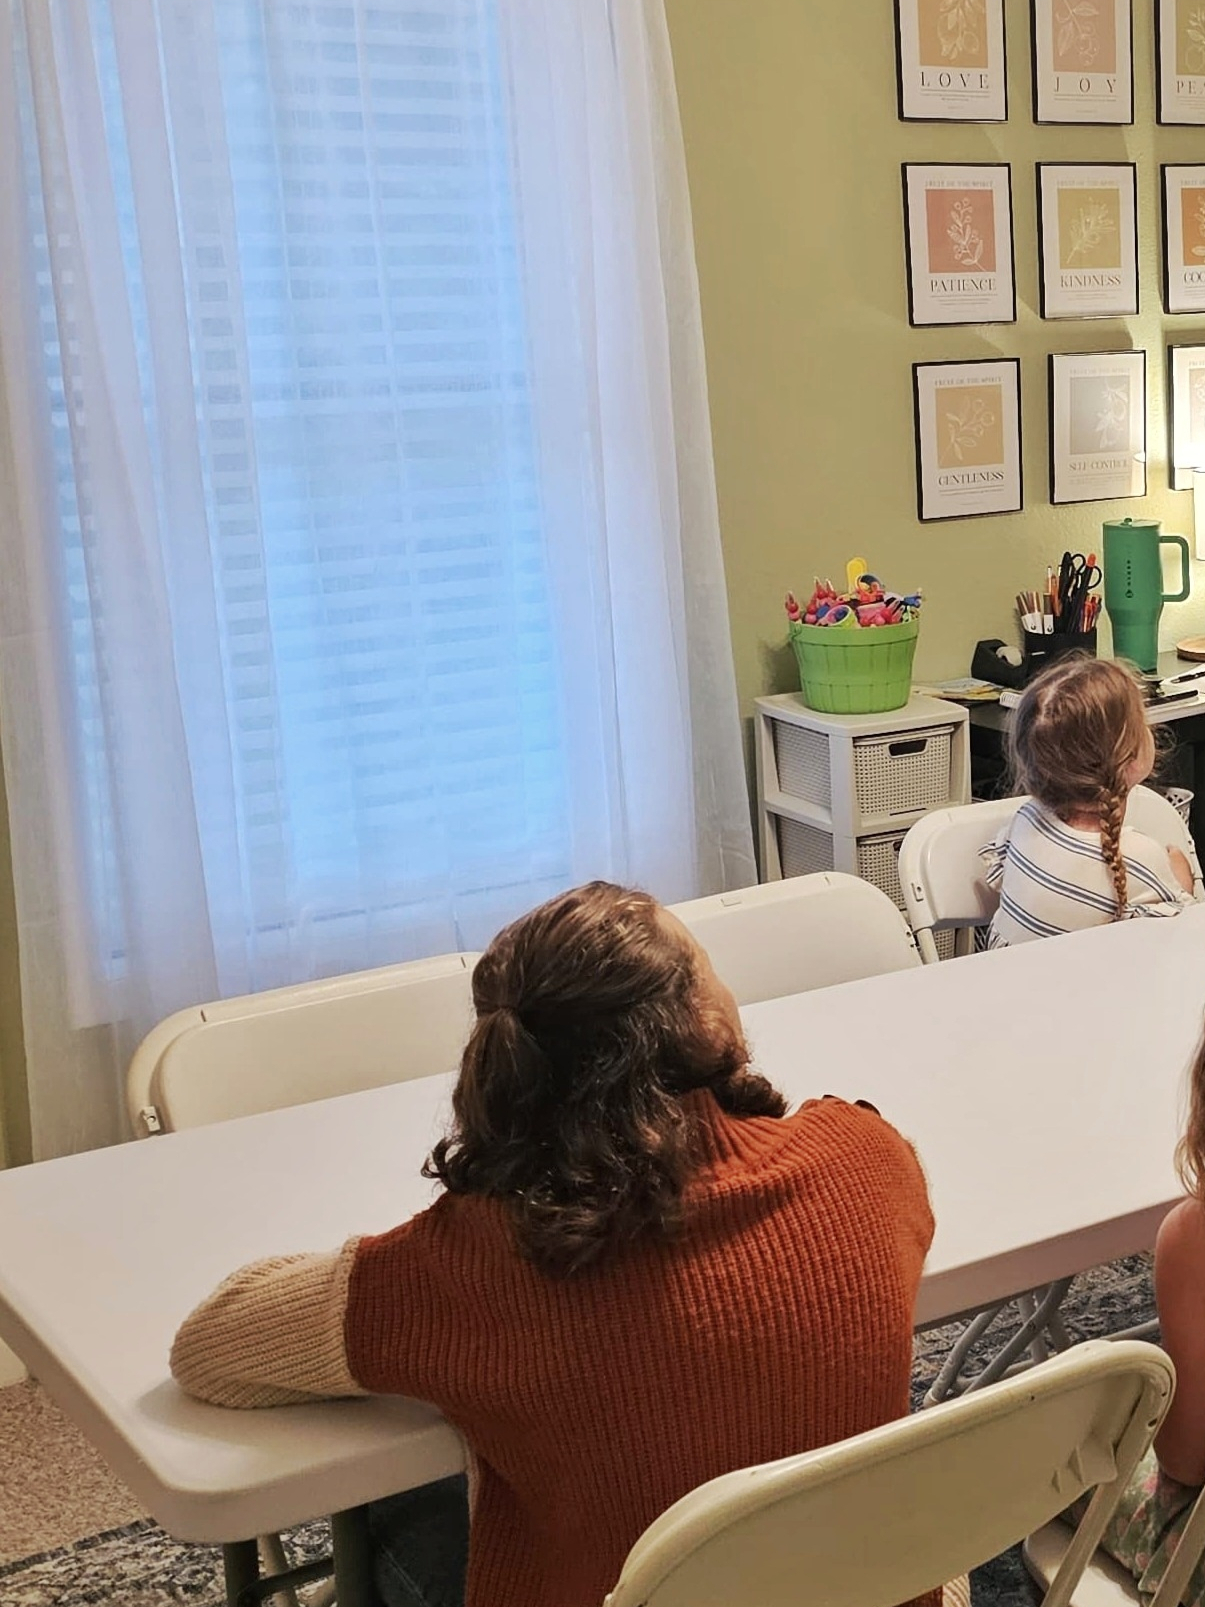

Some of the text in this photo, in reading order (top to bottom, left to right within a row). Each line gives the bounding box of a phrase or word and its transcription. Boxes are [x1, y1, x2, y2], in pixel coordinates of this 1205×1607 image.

[920, 71, 989, 89] LOVE
[1053, 76, 1117, 94] JOY
[930, 278, 997, 292] PATIENCE
[1060, 274, 1121, 288] KINDNESS
[938, 471, 1004, 486] GENTLENESS
